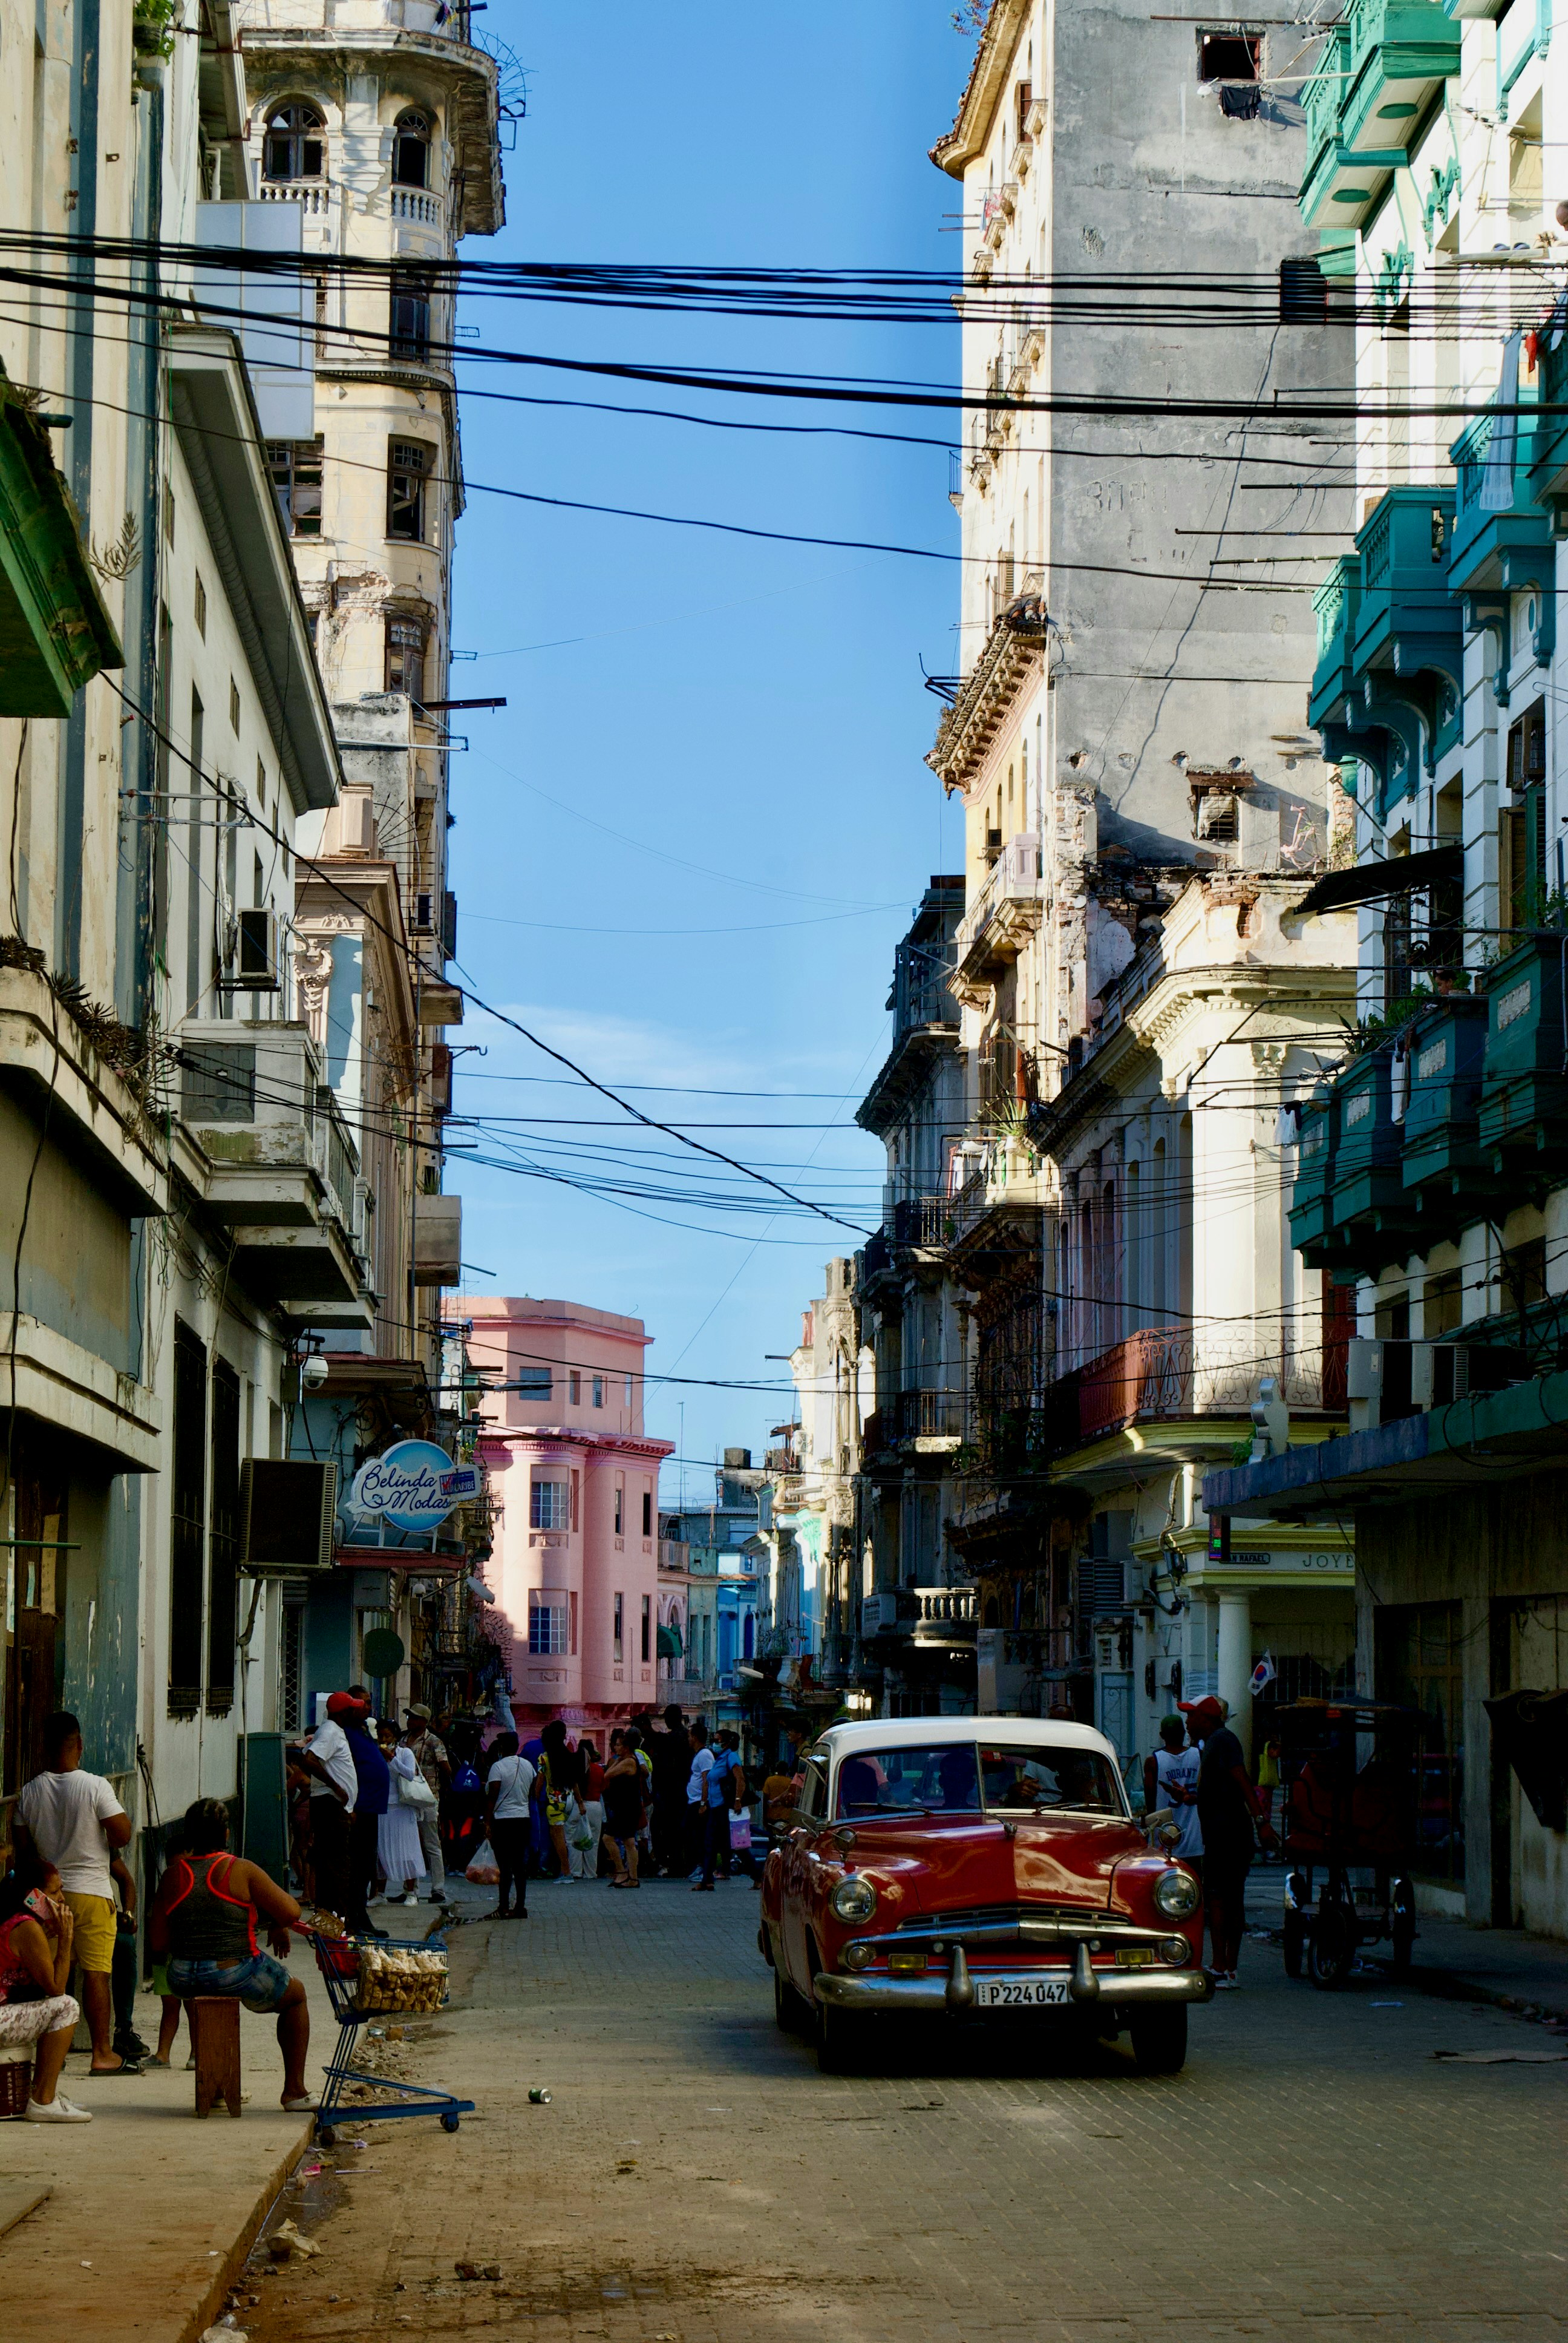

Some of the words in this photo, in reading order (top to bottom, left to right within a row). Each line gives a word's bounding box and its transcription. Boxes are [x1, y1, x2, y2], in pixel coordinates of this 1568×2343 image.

[364, 1464, 437, 1490] Belinda
[391, 1487, 450, 1511] Modas
[1302, 1554, 1354, 1567] JOYE
[1166, 1768, 1197, 1781] DURANT
[1036, 1984, 1065, 2002] 047
